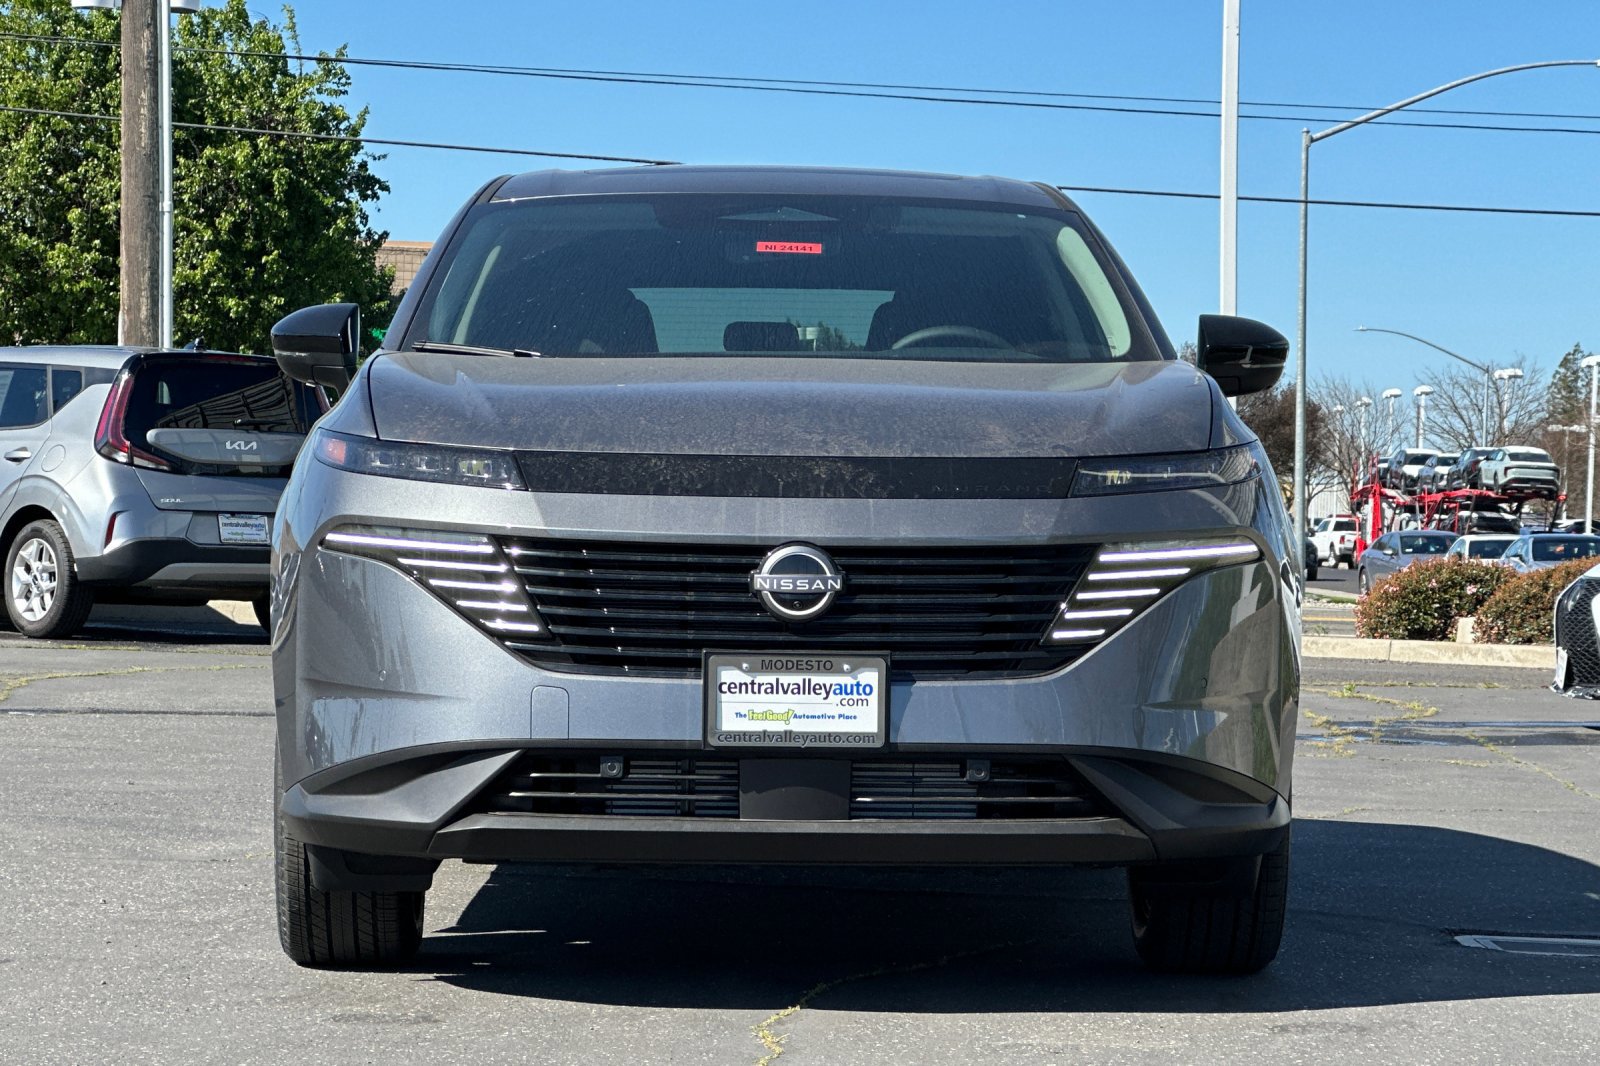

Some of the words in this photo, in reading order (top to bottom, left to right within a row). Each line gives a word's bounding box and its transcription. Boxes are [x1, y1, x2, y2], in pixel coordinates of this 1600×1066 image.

[225, 440, 257, 450] KIA
[756, 578, 841, 590] NISSAN
[760, 659, 834, 671] MODESTO
[718, 677, 874, 700] centralvalleyauto
[835, 697, 869, 707] .com
[717, 729, 875, 748] centralvalleyauto.com
